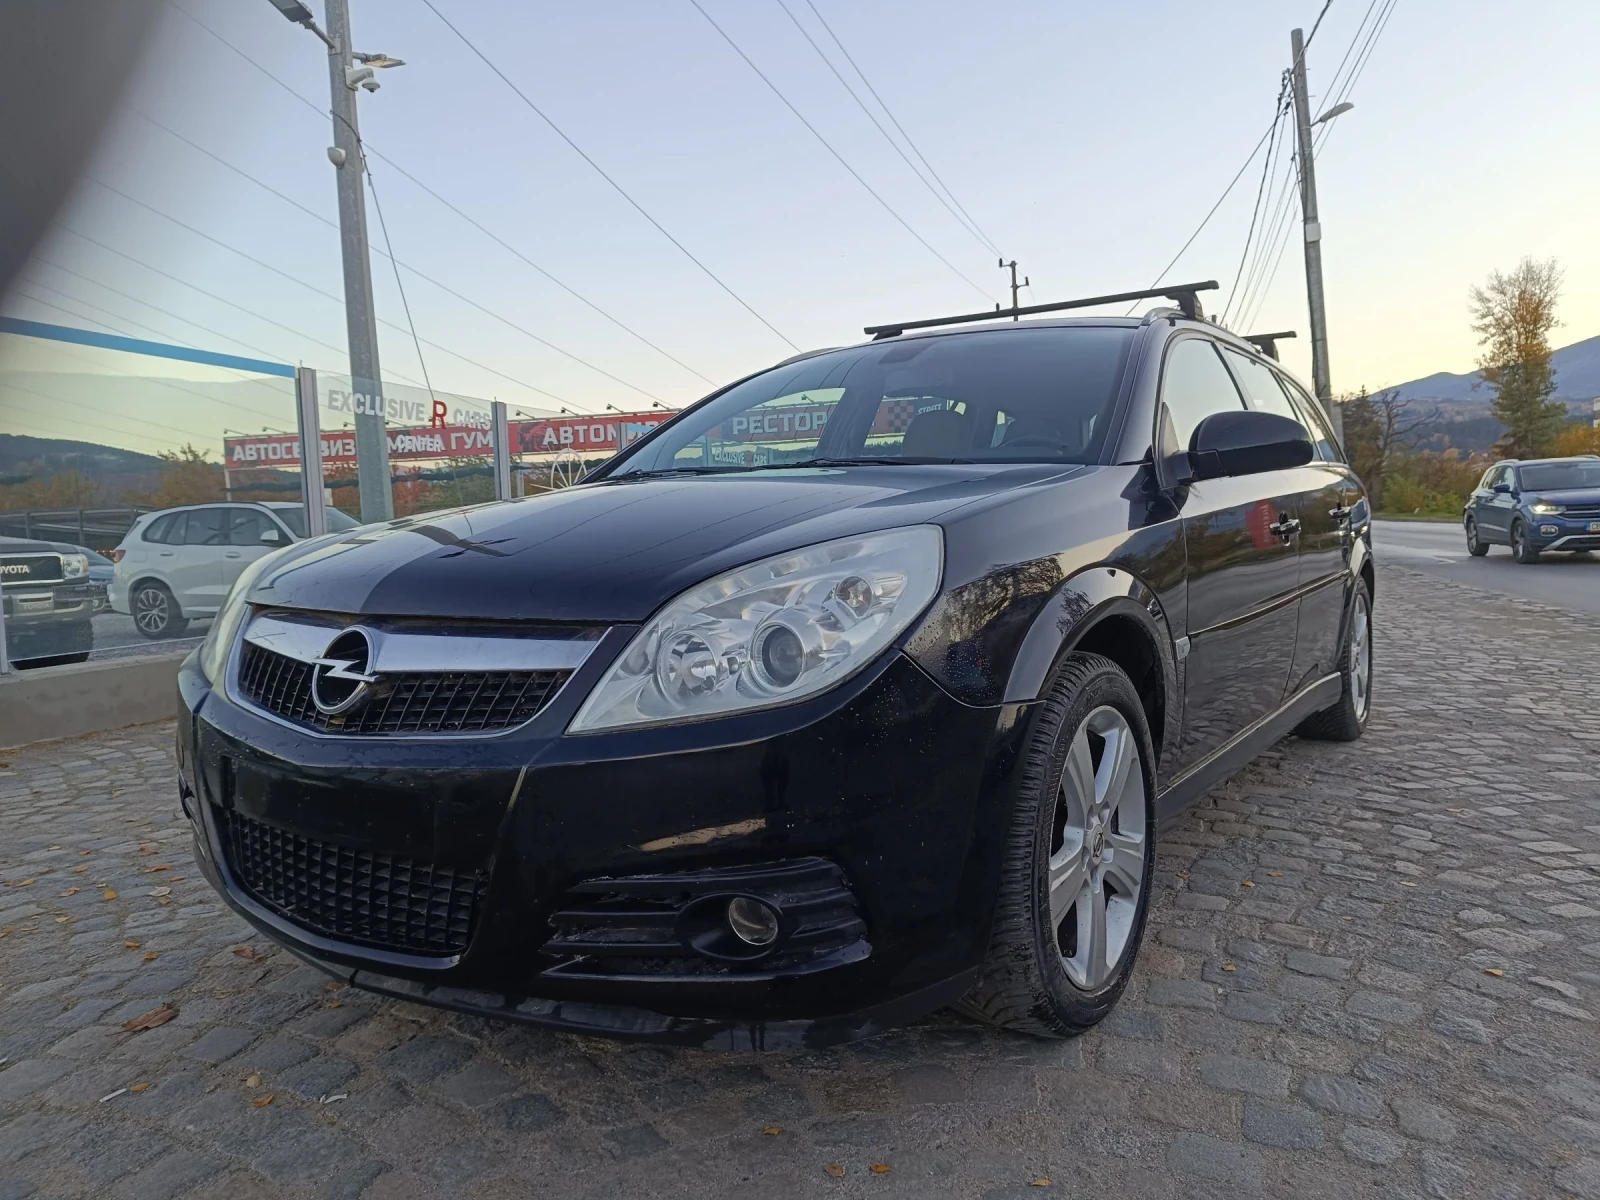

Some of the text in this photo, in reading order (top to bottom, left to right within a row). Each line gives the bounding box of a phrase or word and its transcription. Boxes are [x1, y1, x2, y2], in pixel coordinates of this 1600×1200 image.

[328, 389, 491, 430] EXCLUSIVE R CARS
[732, 411, 828, 434] РЕСТОР
[233, 439, 356, 461] АВТОСЕВИЗ
[450, 431, 494, 450] ГУМ
[0, 565, 30, 574] YOTA
